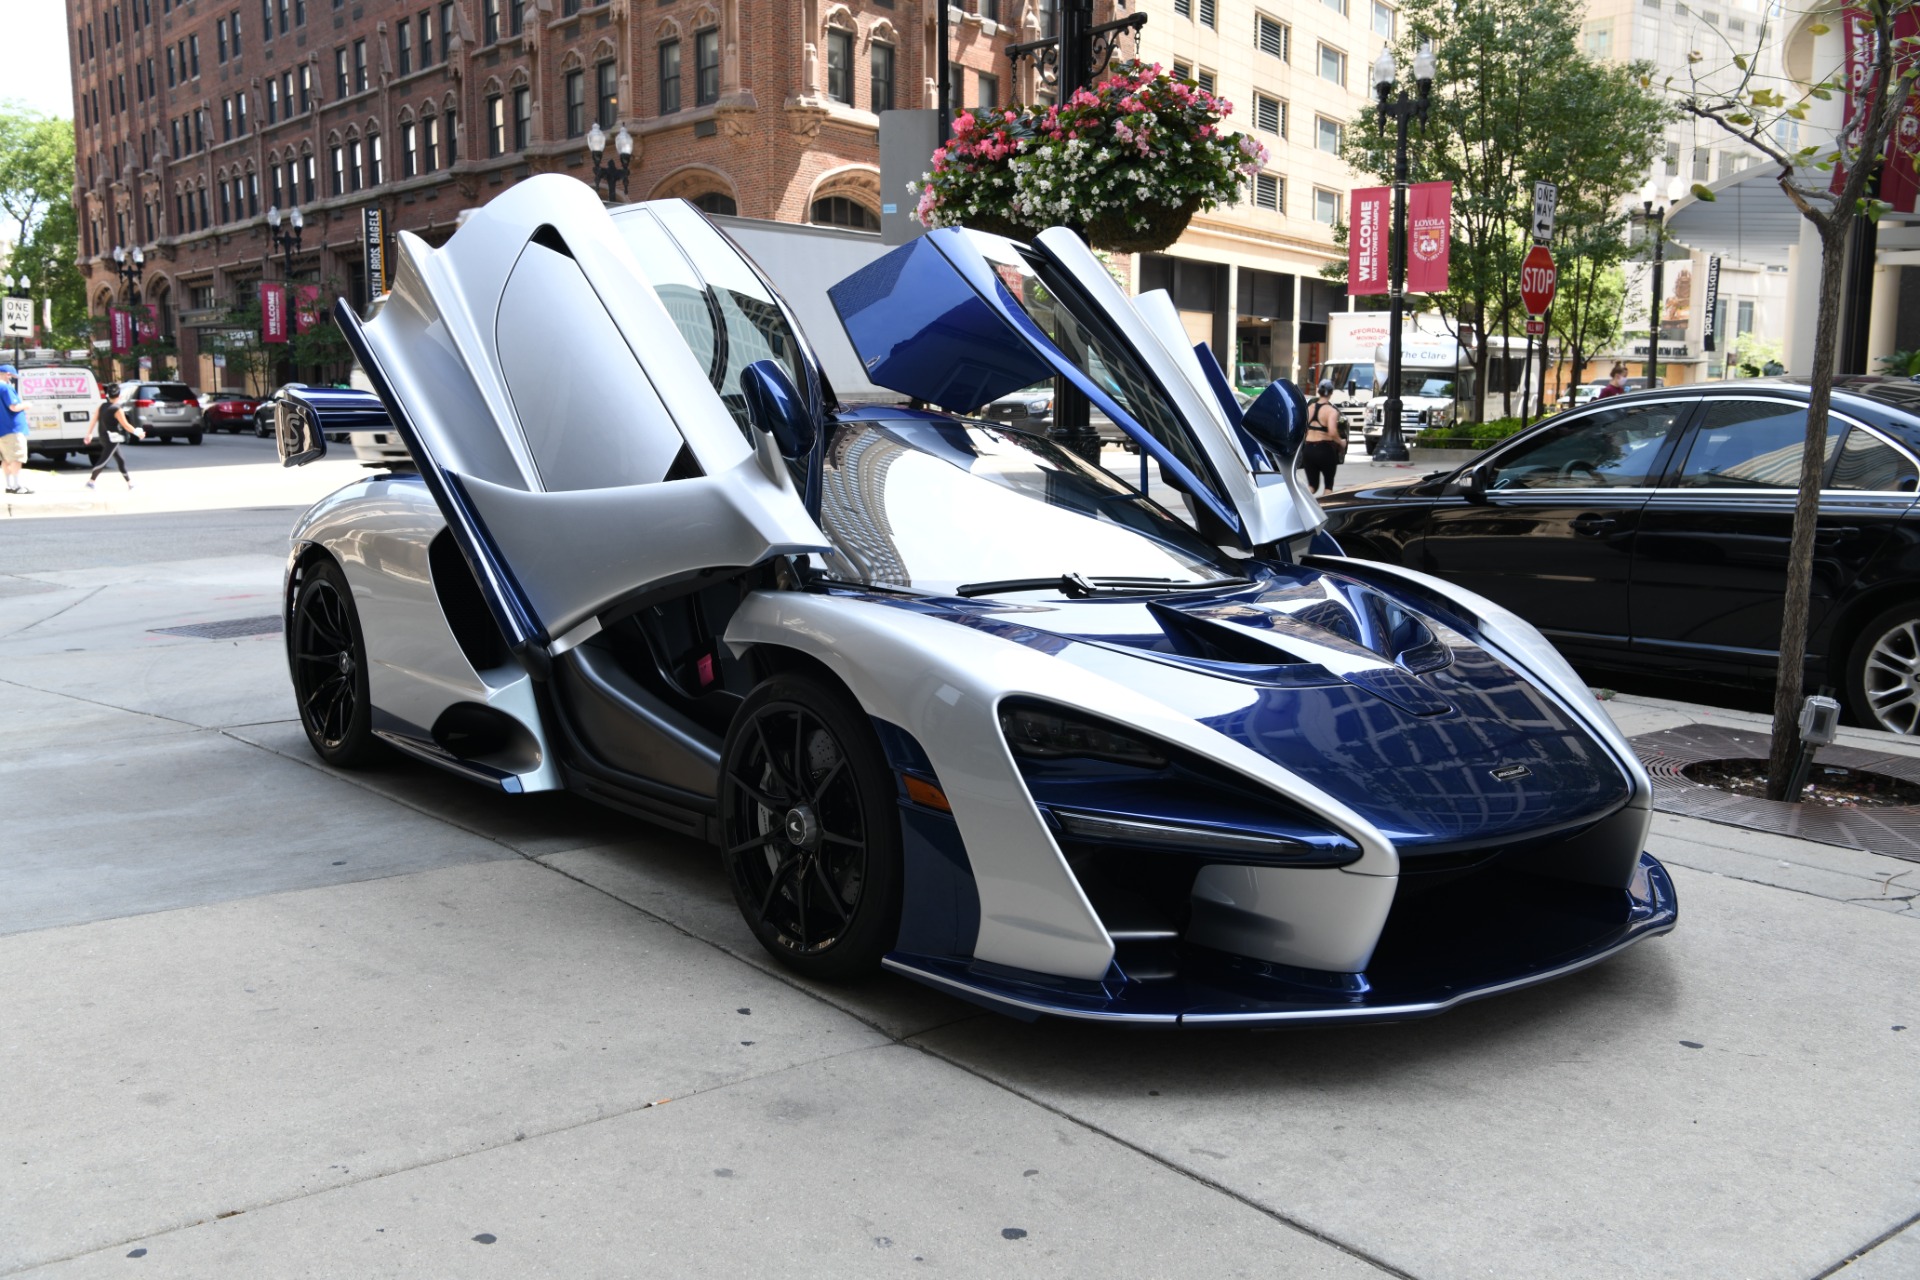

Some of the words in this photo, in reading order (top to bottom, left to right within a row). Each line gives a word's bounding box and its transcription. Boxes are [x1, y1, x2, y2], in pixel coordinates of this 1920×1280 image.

[1538, 187, 1554, 202] ONE
[1537, 204, 1553, 218] WAY
[368, 210, 380, 244] BAGELS
[1414, 218, 1445, 227] LOYOLA
[1359, 201, 1372, 282] WELCOME
[1523, 267, 1554, 294] STOP
[1707, 257, 1718, 311] NORDSTROM
[7, 302, 29, 312] ONE
[267, 291, 277, 335] WELCOME
[7, 312, 29, 321] WAY
[1704, 313, 1714, 335] rack
[1350, 327, 1390, 336] AFFORDABL
[1401, 351, 1417, 359] The
[1421, 351, 1447, 359] Clare
[23, 378, 87, 394] SHAVITZ
